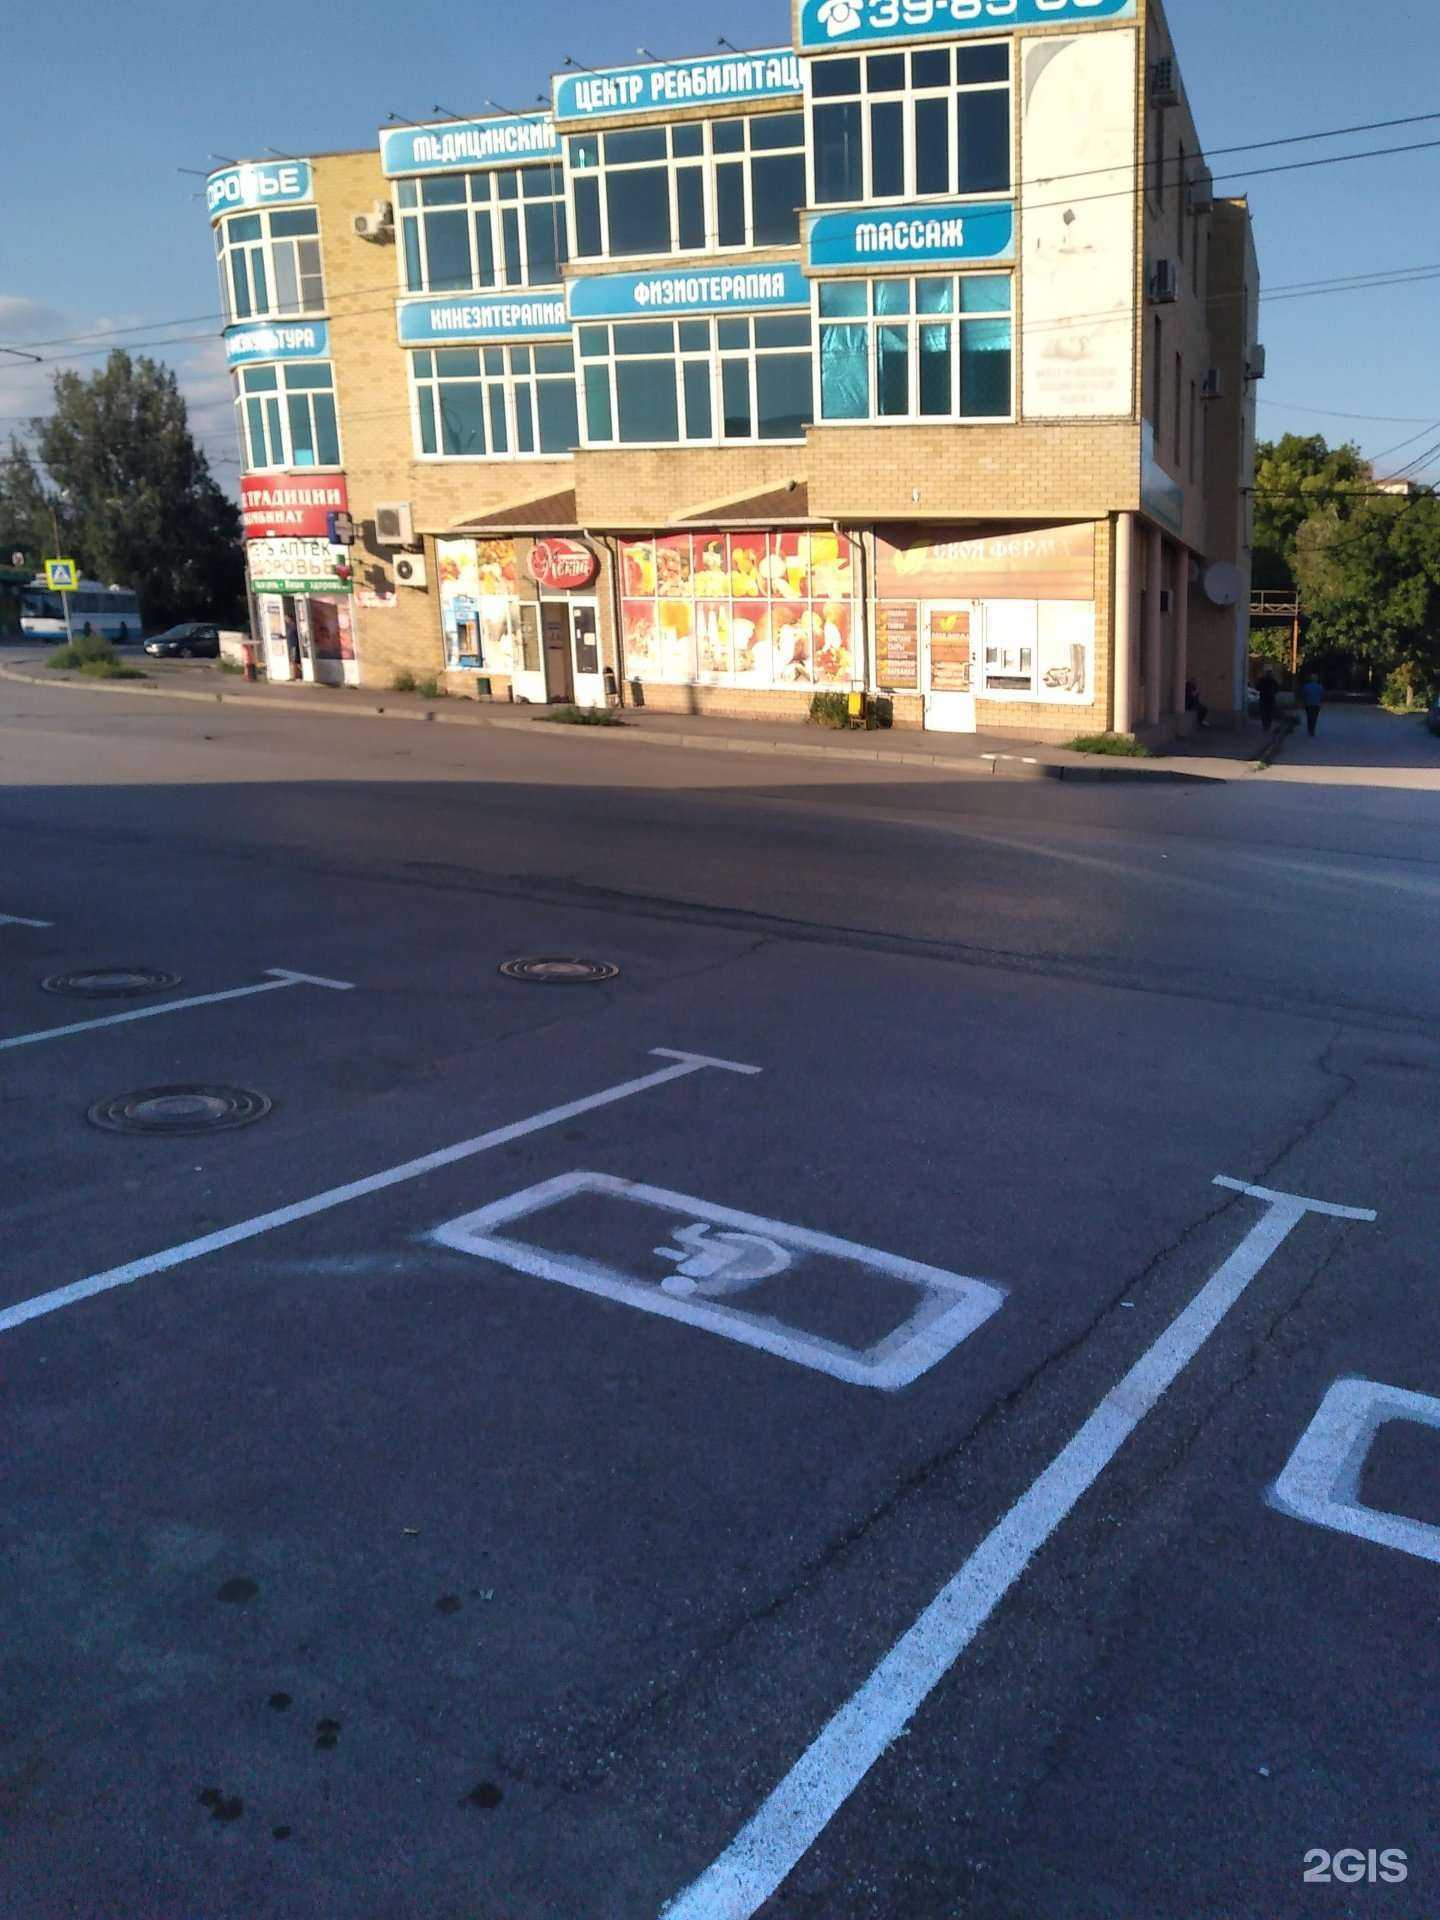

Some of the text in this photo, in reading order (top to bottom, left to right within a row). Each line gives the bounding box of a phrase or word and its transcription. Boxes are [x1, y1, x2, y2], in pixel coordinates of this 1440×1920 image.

[575, 74, 643, 112] ЦЕНТР
[412, 117, 557, 162] МЕДИЦИНСКИЙ
[855, 218, 964, 252] МАССАЖ
[634, 273, 784, 306] ФИЗИОТЕРАПИЯ
[431, 302, 565, 330] КИНЕЗИТЕРАПИЯ
